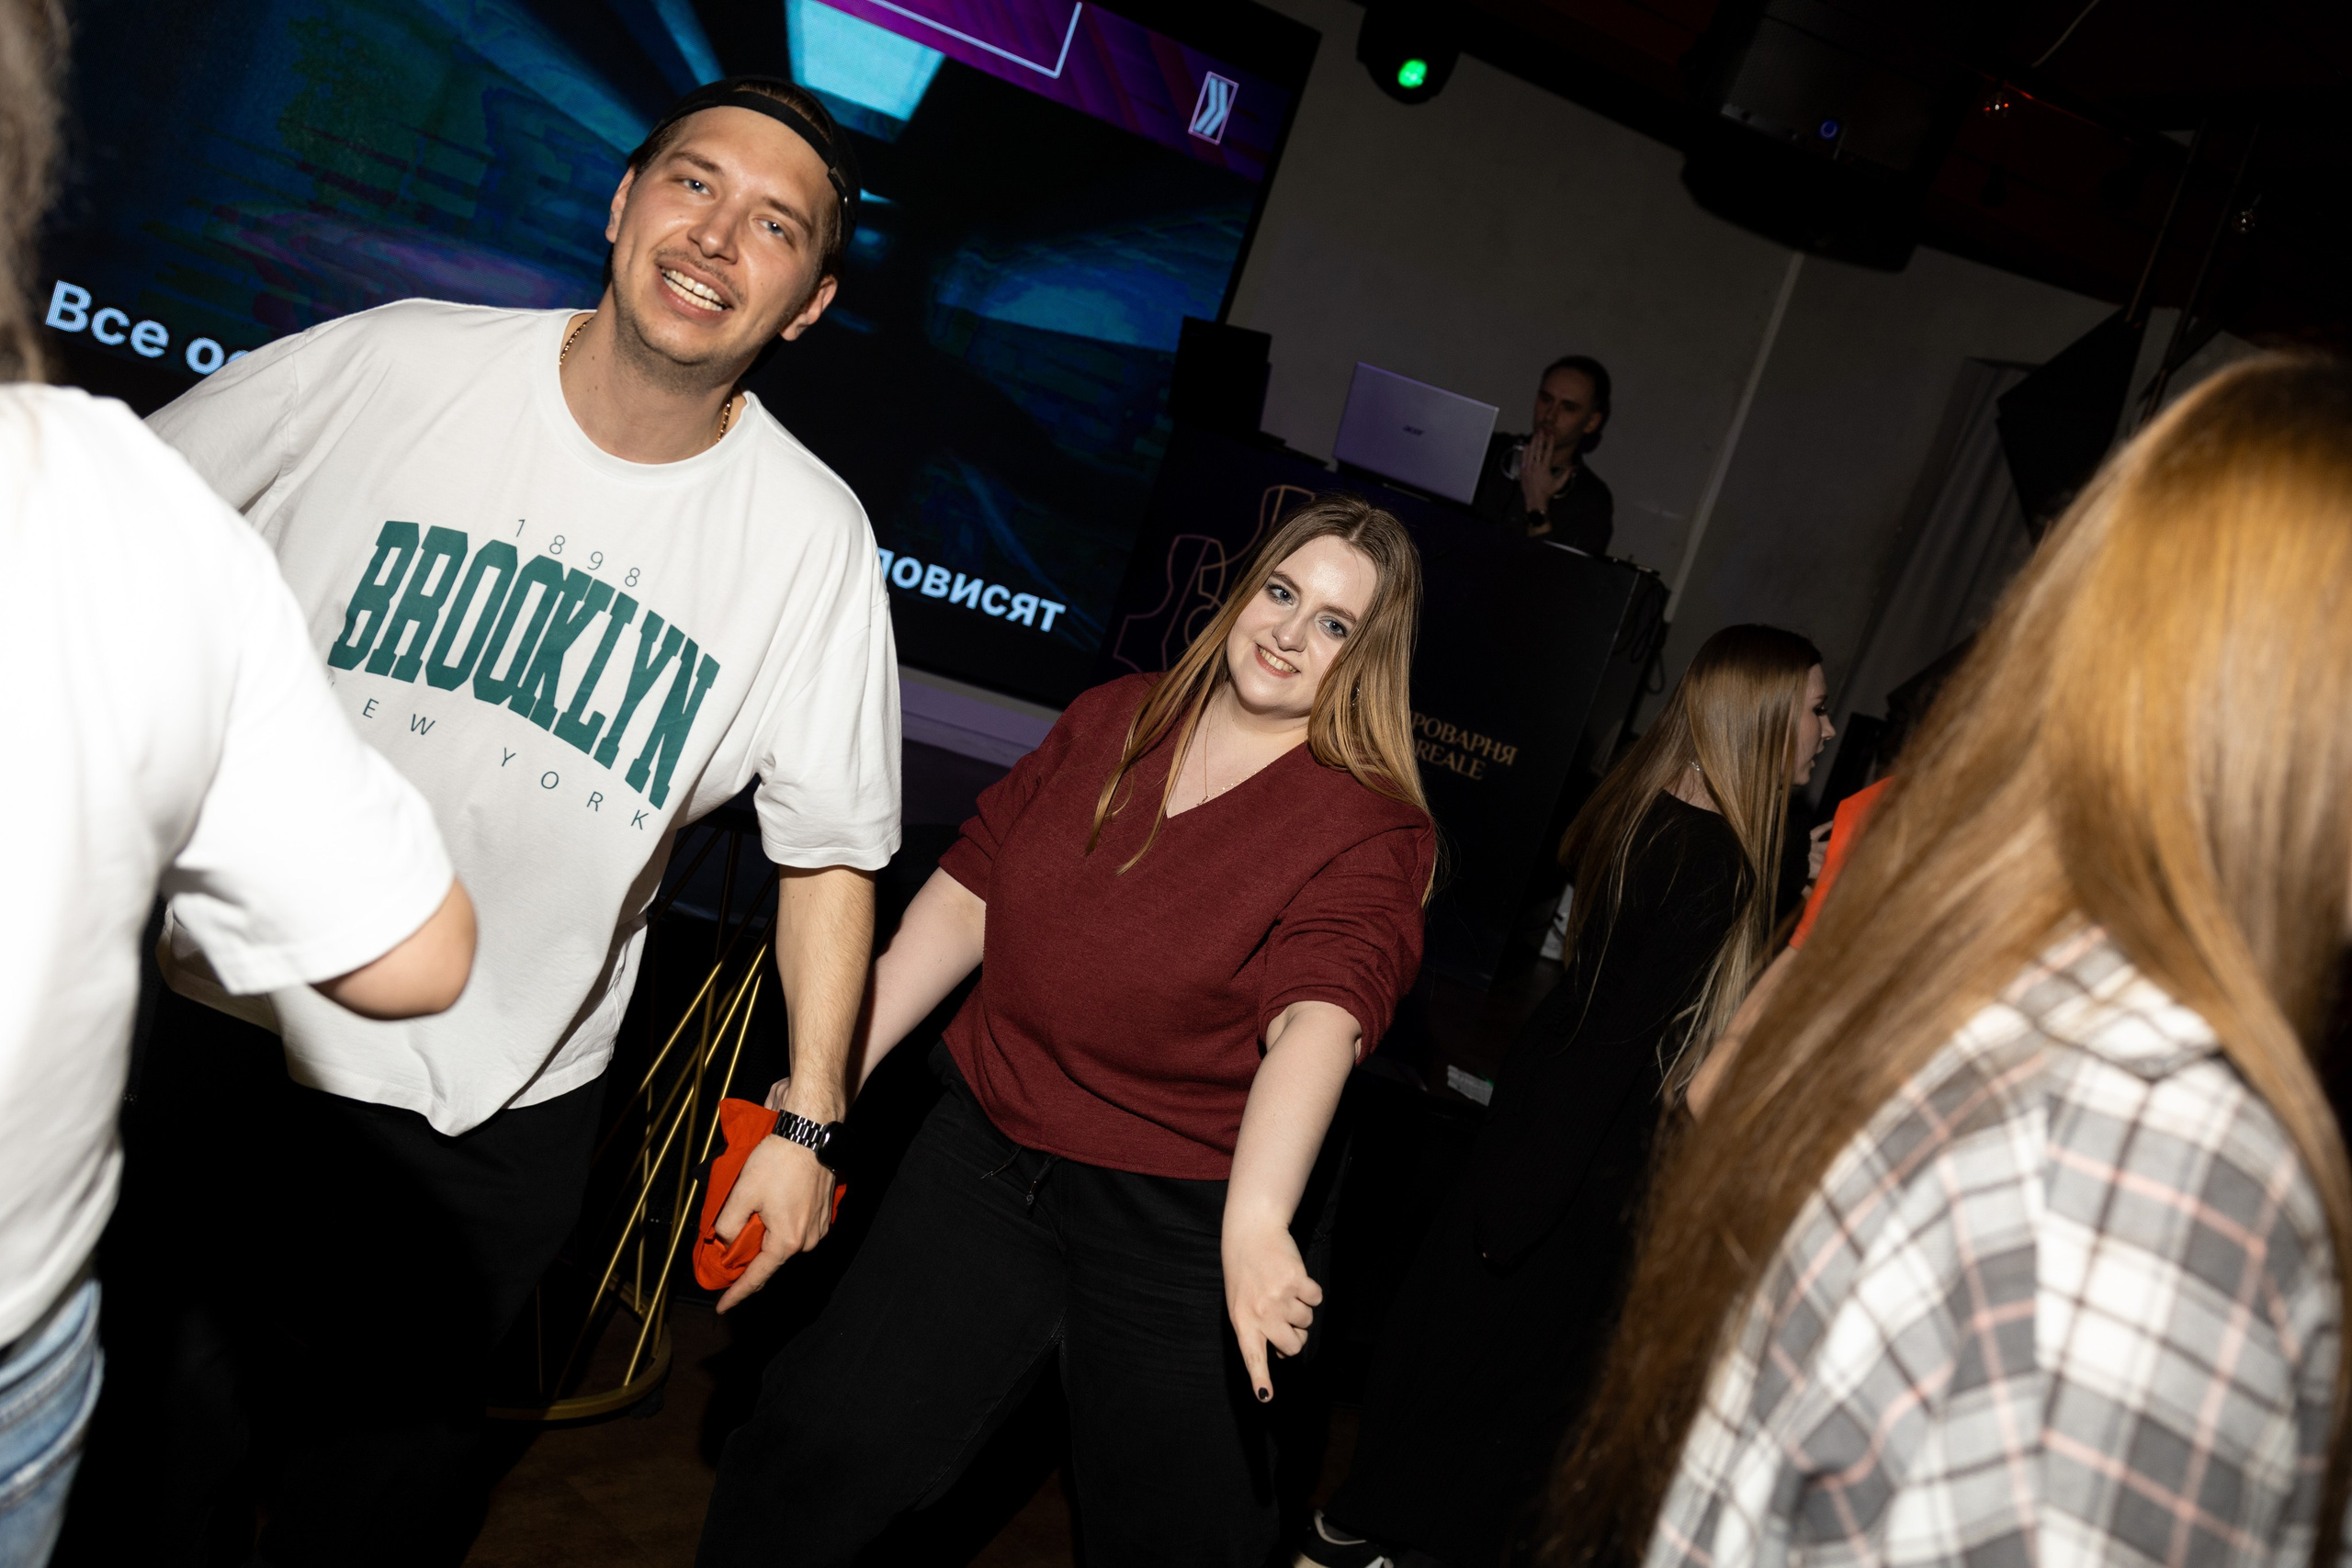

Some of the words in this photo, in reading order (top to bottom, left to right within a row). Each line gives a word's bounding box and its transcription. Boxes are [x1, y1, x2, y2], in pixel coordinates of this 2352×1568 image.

[46, 280, 169, 358] Все
[515, 519, 640, 587] 1898
[327, 520, 720, 810] BROOKLYN
[1411, 711, 1518, 766] РОВАРНЯ
[501, 747, 649, 830] YORK
